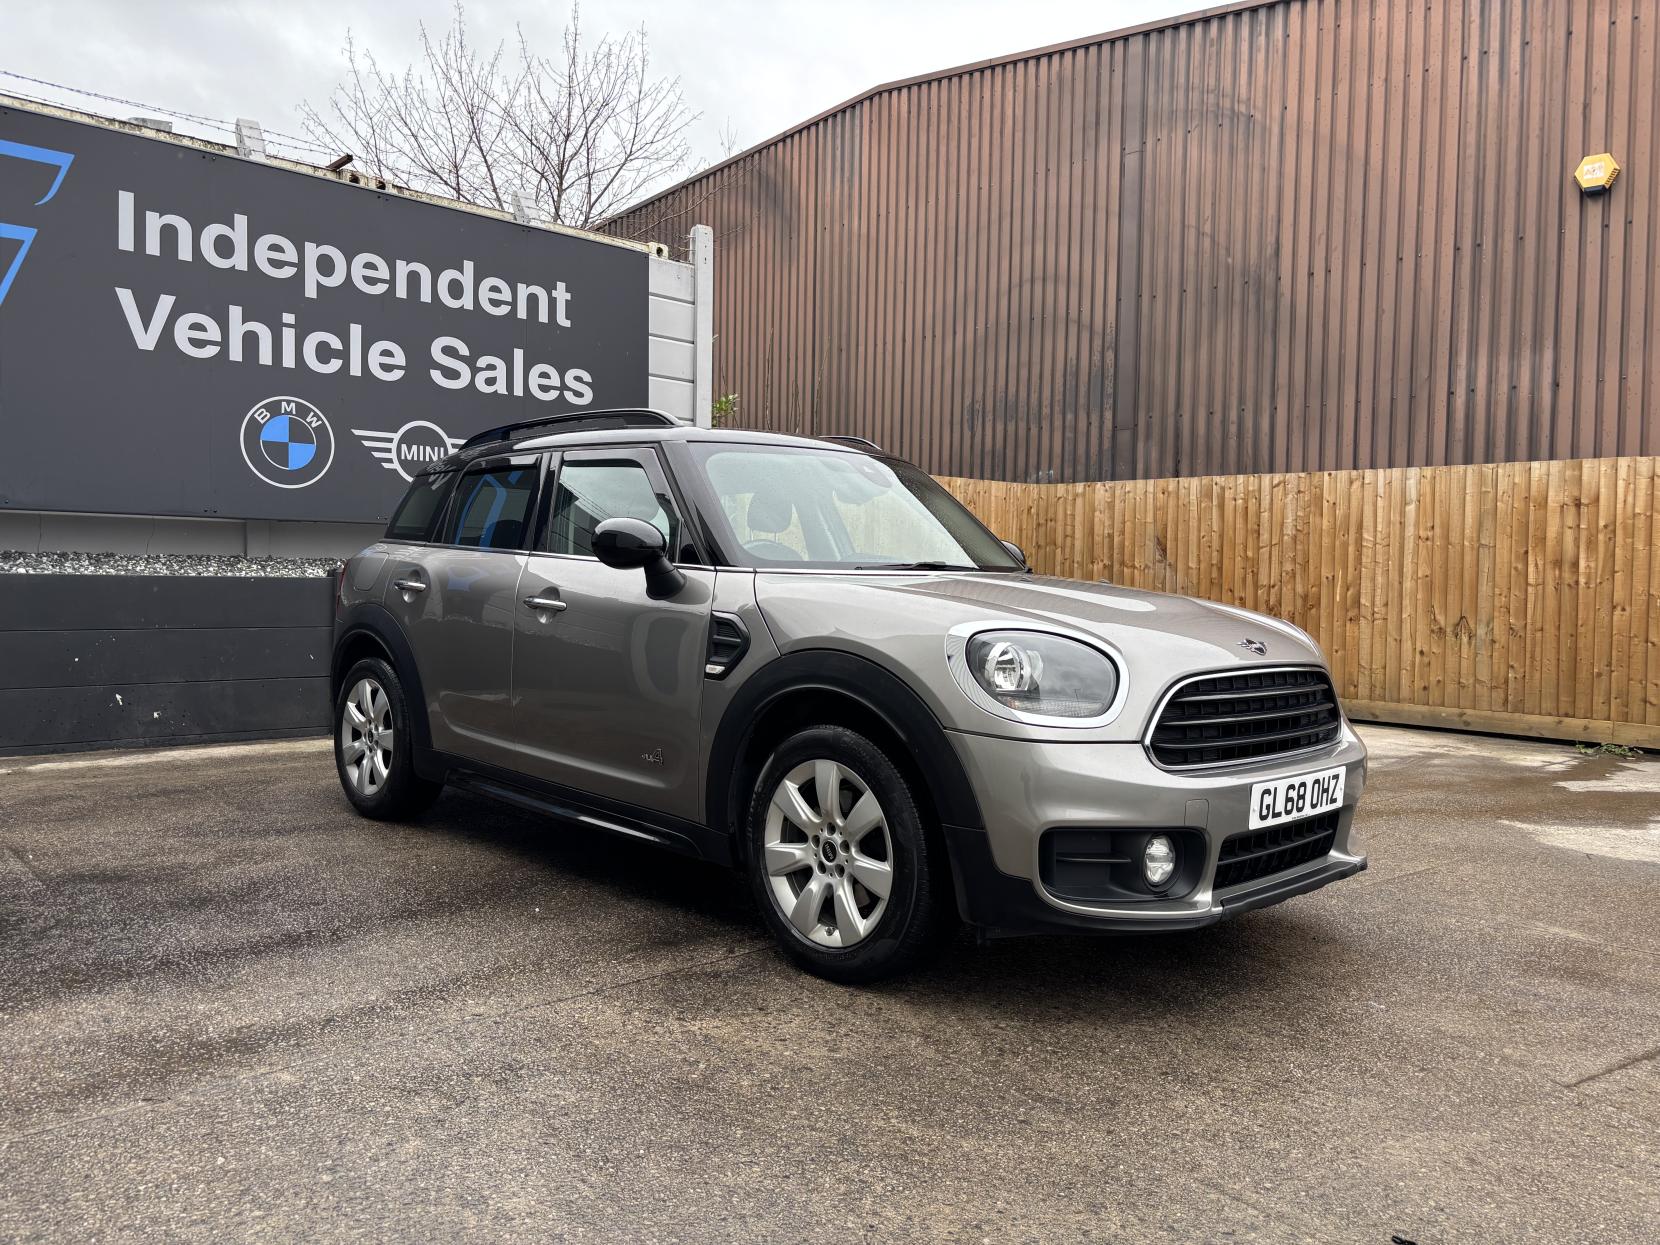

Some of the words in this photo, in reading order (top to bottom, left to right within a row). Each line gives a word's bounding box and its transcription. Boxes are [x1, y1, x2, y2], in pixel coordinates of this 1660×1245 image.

[118, 189, 572, 328] Independent
[114, 286, 406, 382] Vehicle
[429, 336, 594, 406] Sales
[253, 401, 323, 428] BMW
[401, 443, 445, 462] MINI
[1258, 781, 1307, 821] GL68
[1310, 773, 1340, 810] OHZ
